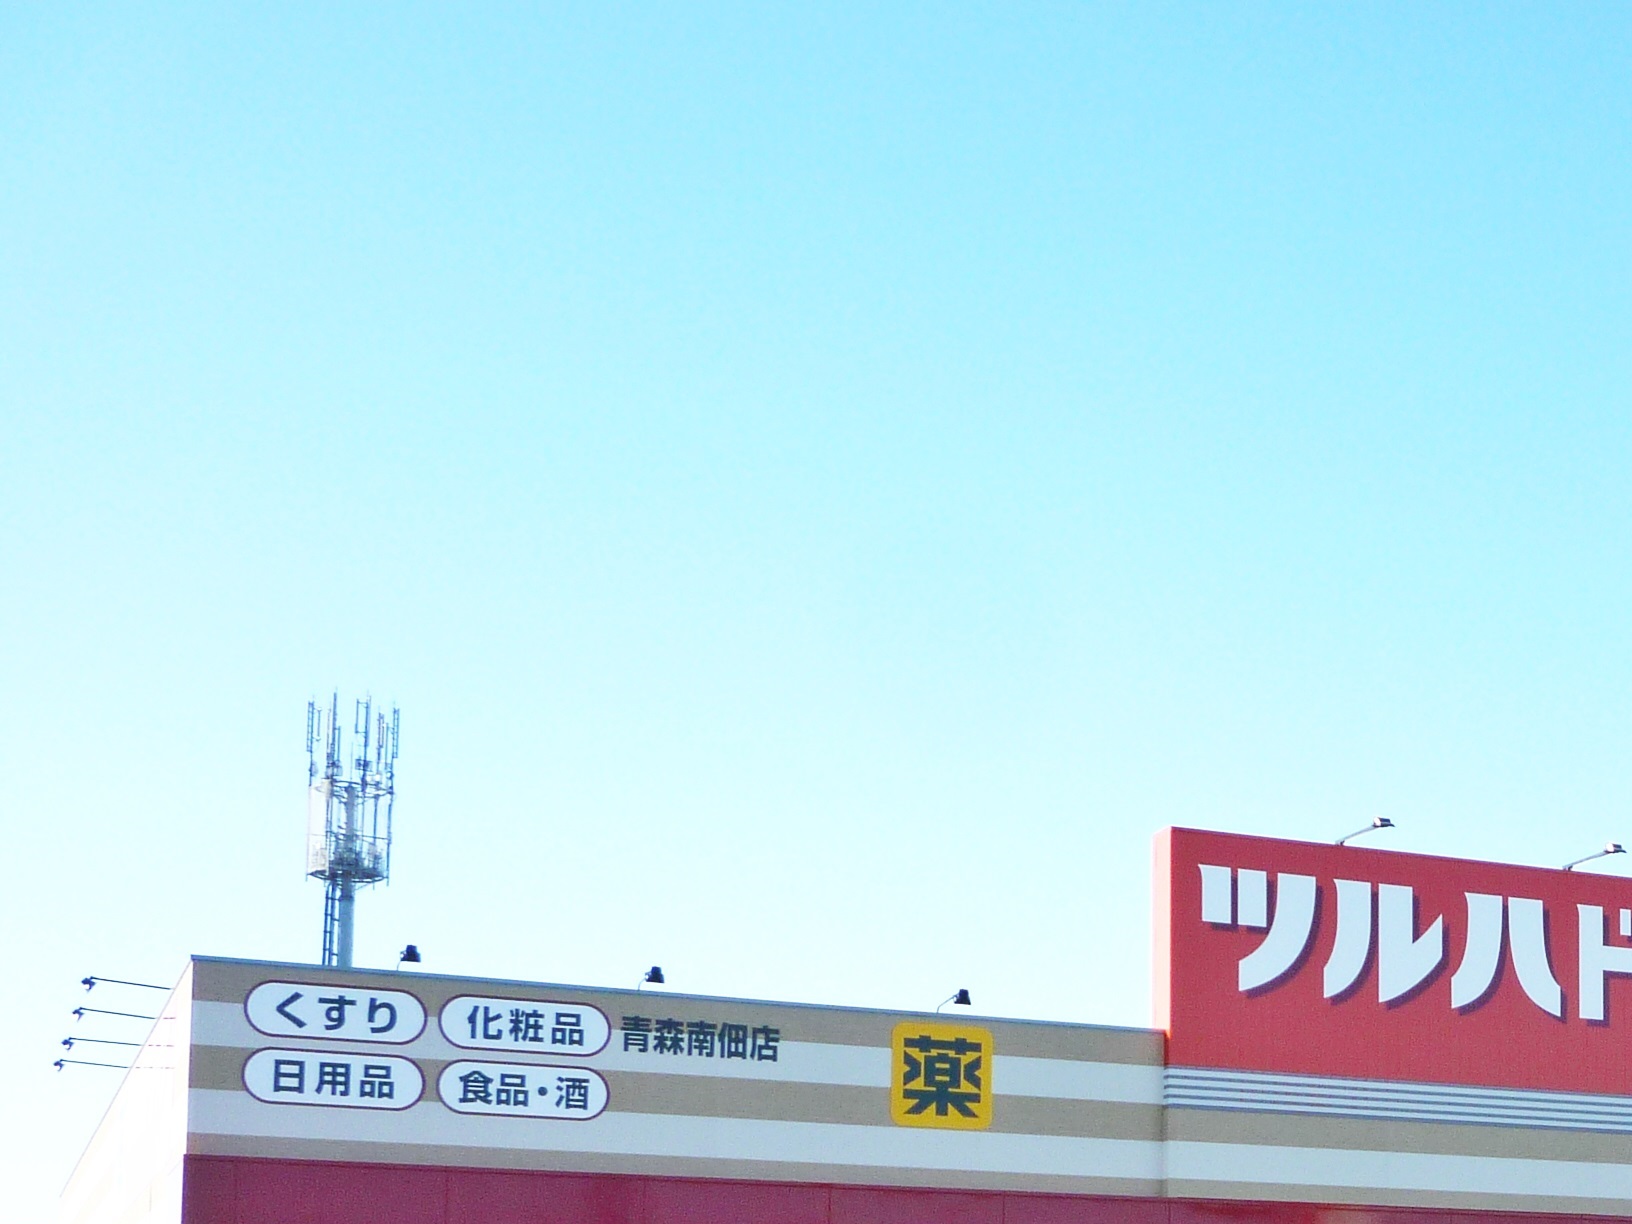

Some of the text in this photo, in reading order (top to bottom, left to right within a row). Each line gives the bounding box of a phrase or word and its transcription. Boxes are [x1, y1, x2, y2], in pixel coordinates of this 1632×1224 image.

[275, 991, 398, 1034] くすり
[467, 1005, 584, 1046] 化粧品
[620, 1015, 780, 1062] 青森南佃店
[273, 1058, 395, 1100] 日用品
[458, 1070, 590, 1111] 食品・酒
[903, 1035, 982, 1119] 薬
